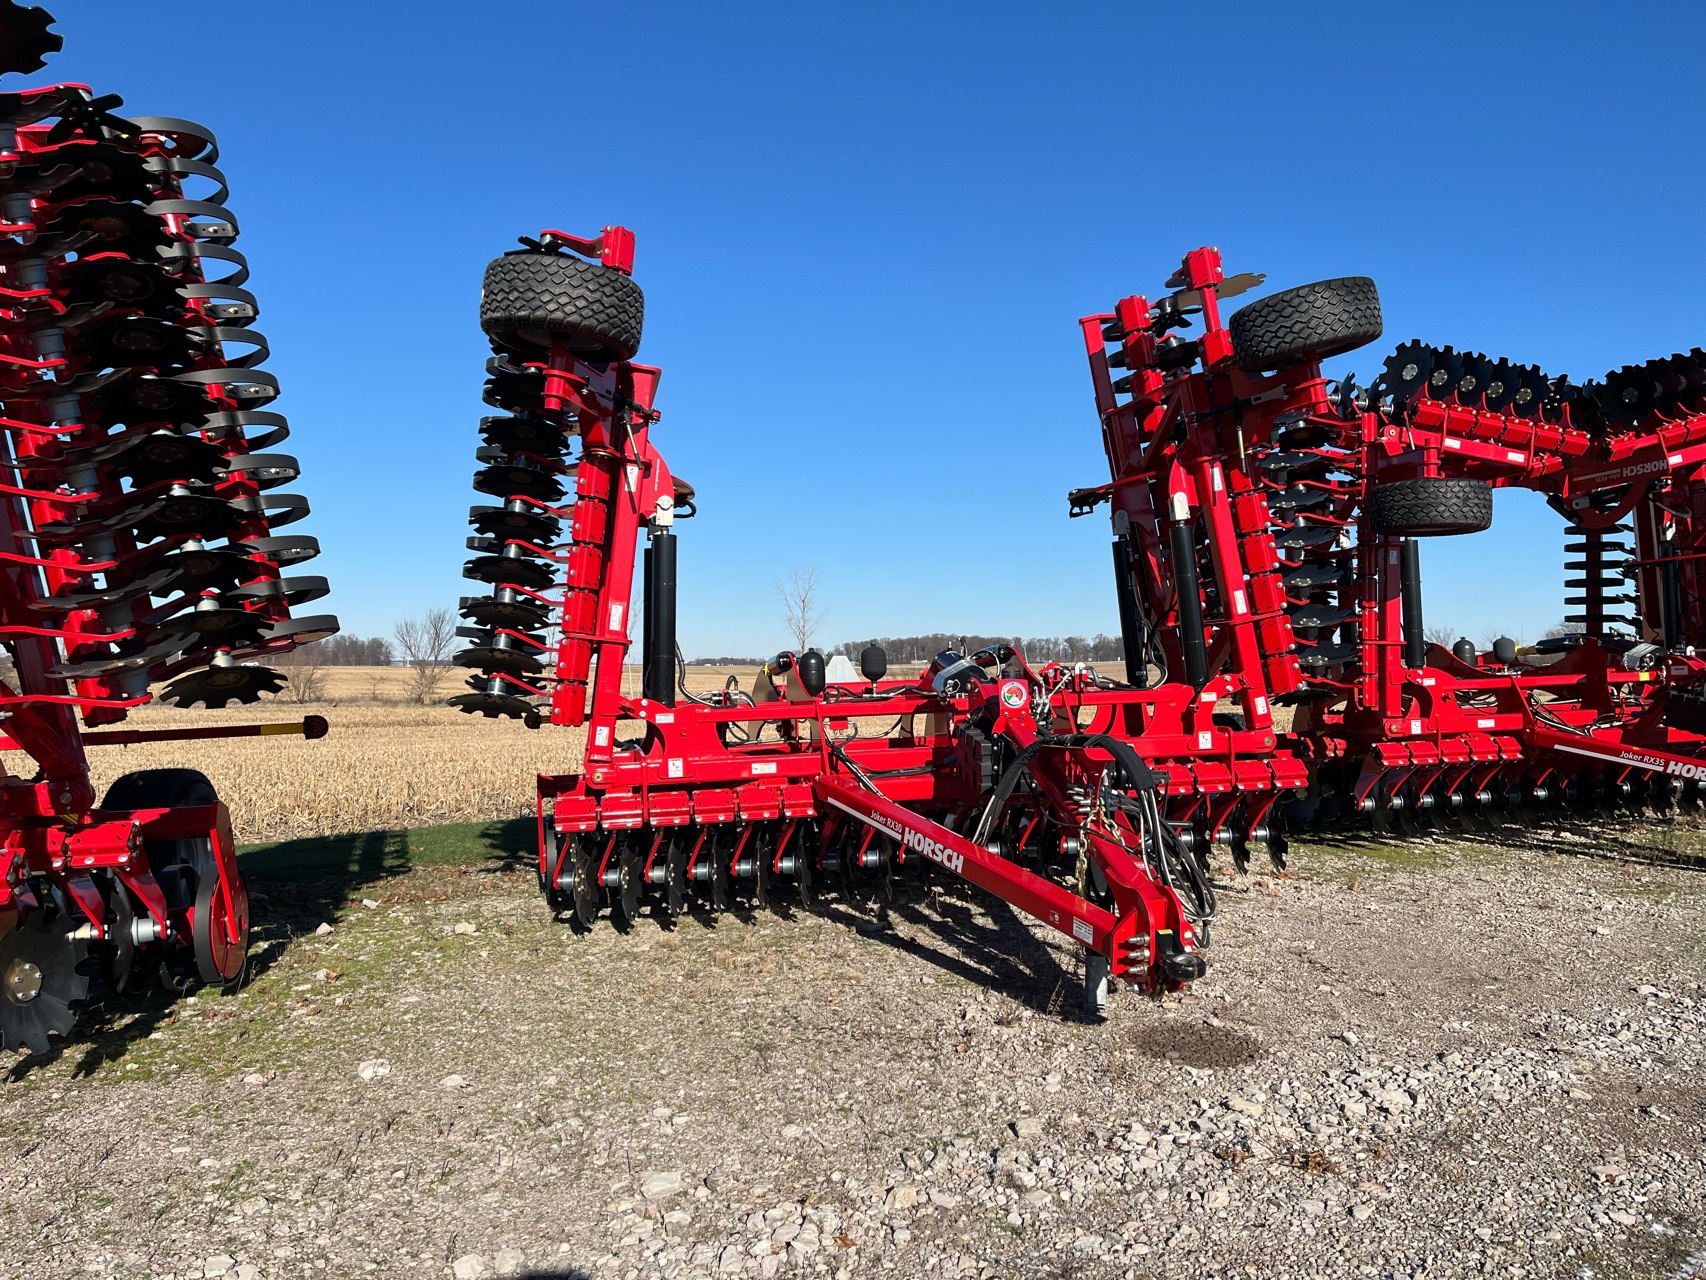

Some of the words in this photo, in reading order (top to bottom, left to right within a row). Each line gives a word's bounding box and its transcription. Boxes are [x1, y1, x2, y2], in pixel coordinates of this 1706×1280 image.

[1622, 460, 1667, 477] HORSCH
[1619, 750, 1643, 761] Joker
[1643, 755, 1666, 766] RX35
[870, 810, 887, 825] Joker
[886, 817, 903, 833] RX30
[903, 827, 964, 874] HORSCH
